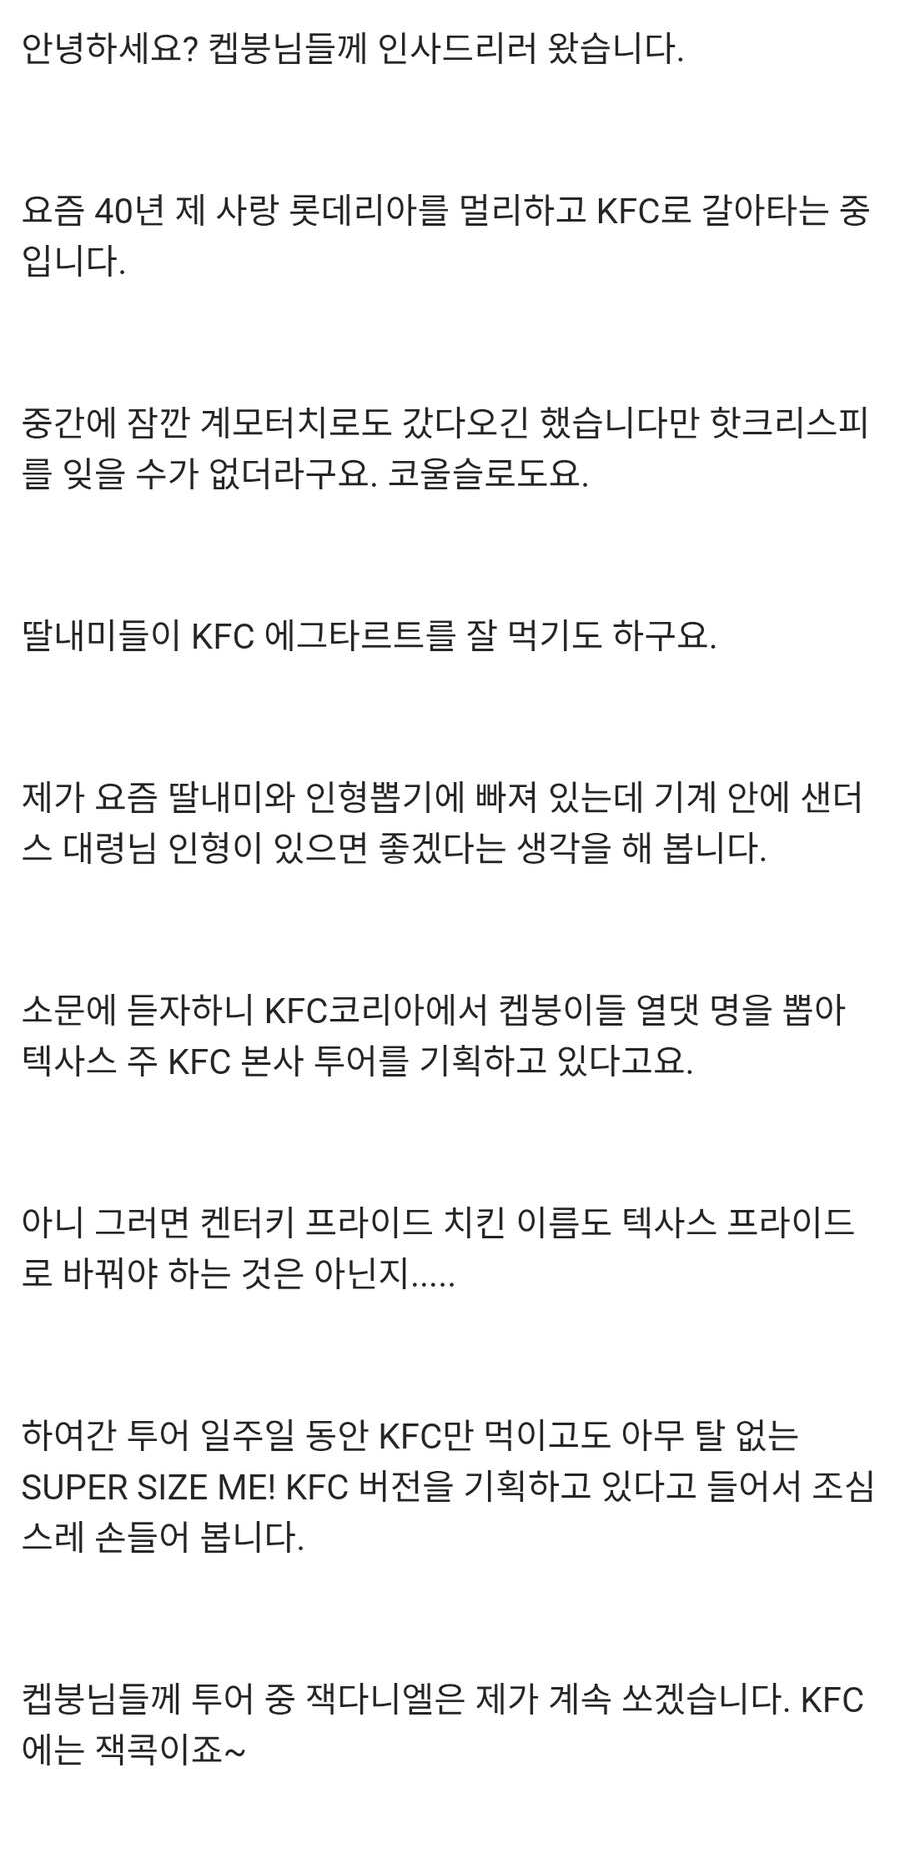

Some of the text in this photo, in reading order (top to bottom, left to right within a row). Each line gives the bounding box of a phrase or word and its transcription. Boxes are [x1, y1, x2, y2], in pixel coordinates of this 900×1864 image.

[23, 32, 683, 64] 안녕하세요? 켑붕님들께 인사드리러 왔습니다.
[22, 1470, 872, 1502] SUPER SIZE ME! KFC 버전을 기획하고 있다고 들어서 조심
